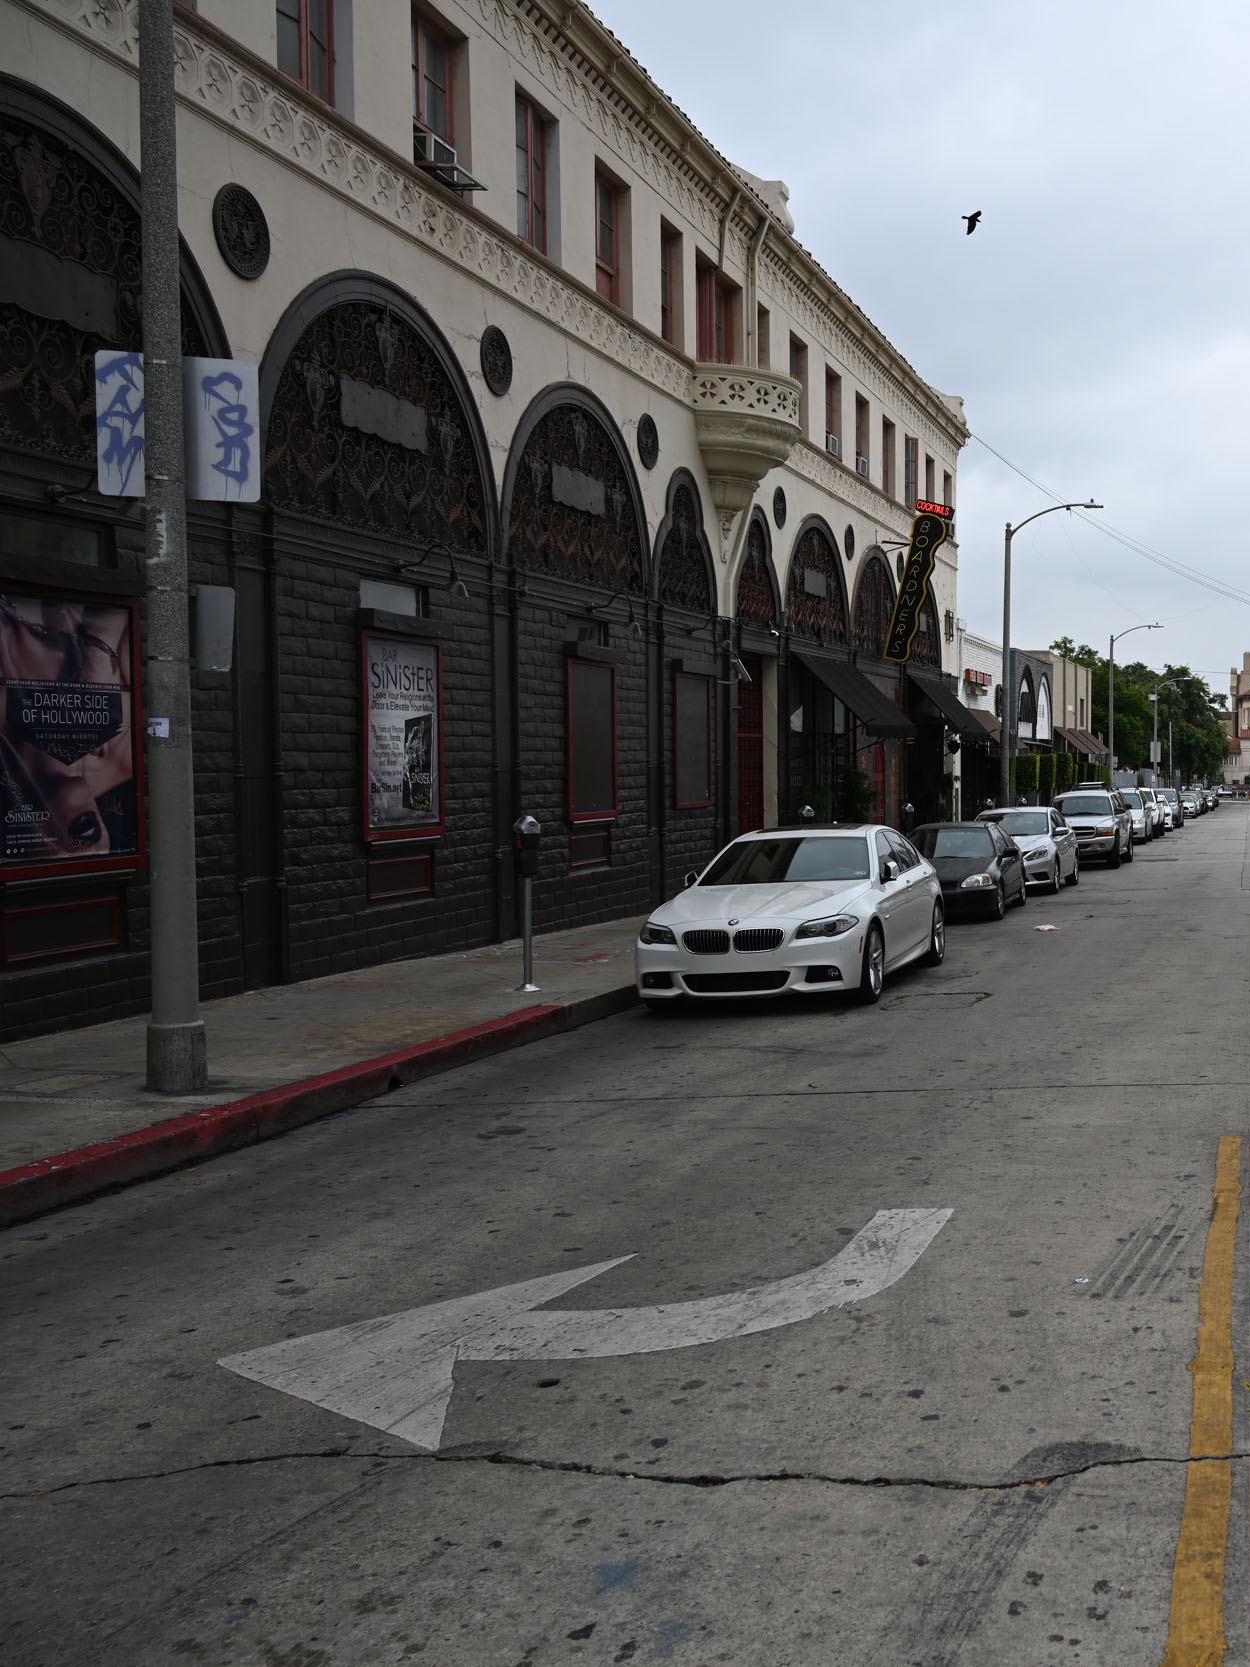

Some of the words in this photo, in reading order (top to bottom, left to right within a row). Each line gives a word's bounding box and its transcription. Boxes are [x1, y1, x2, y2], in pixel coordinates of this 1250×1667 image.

[916, 500, 950, 516] COCKTAILS
[892, 520, 930, 652] BOARDNER'S
[382, 647, 398, 662] BAR
[34, 692, 81, 708] DARKER
[84, 695, 109, 709] SIDE
[373, 690, 387, 699] Leave
[388, 691, 399, 700] Your
[400, 691, 421, 702] Religions
[371, 700, 385, 710] Door
[390, 701, 409, 711] Elevate
[410, 702, 422, 711] Your
[423, 703, 434, 712] Mind
[22, 709, 37, 723] OF
[41, 709, 110, 725] HOLLYWOOD
[371, 782, 402, 794] BarSin.net
[5, 810, 50, 823] SINISTER
